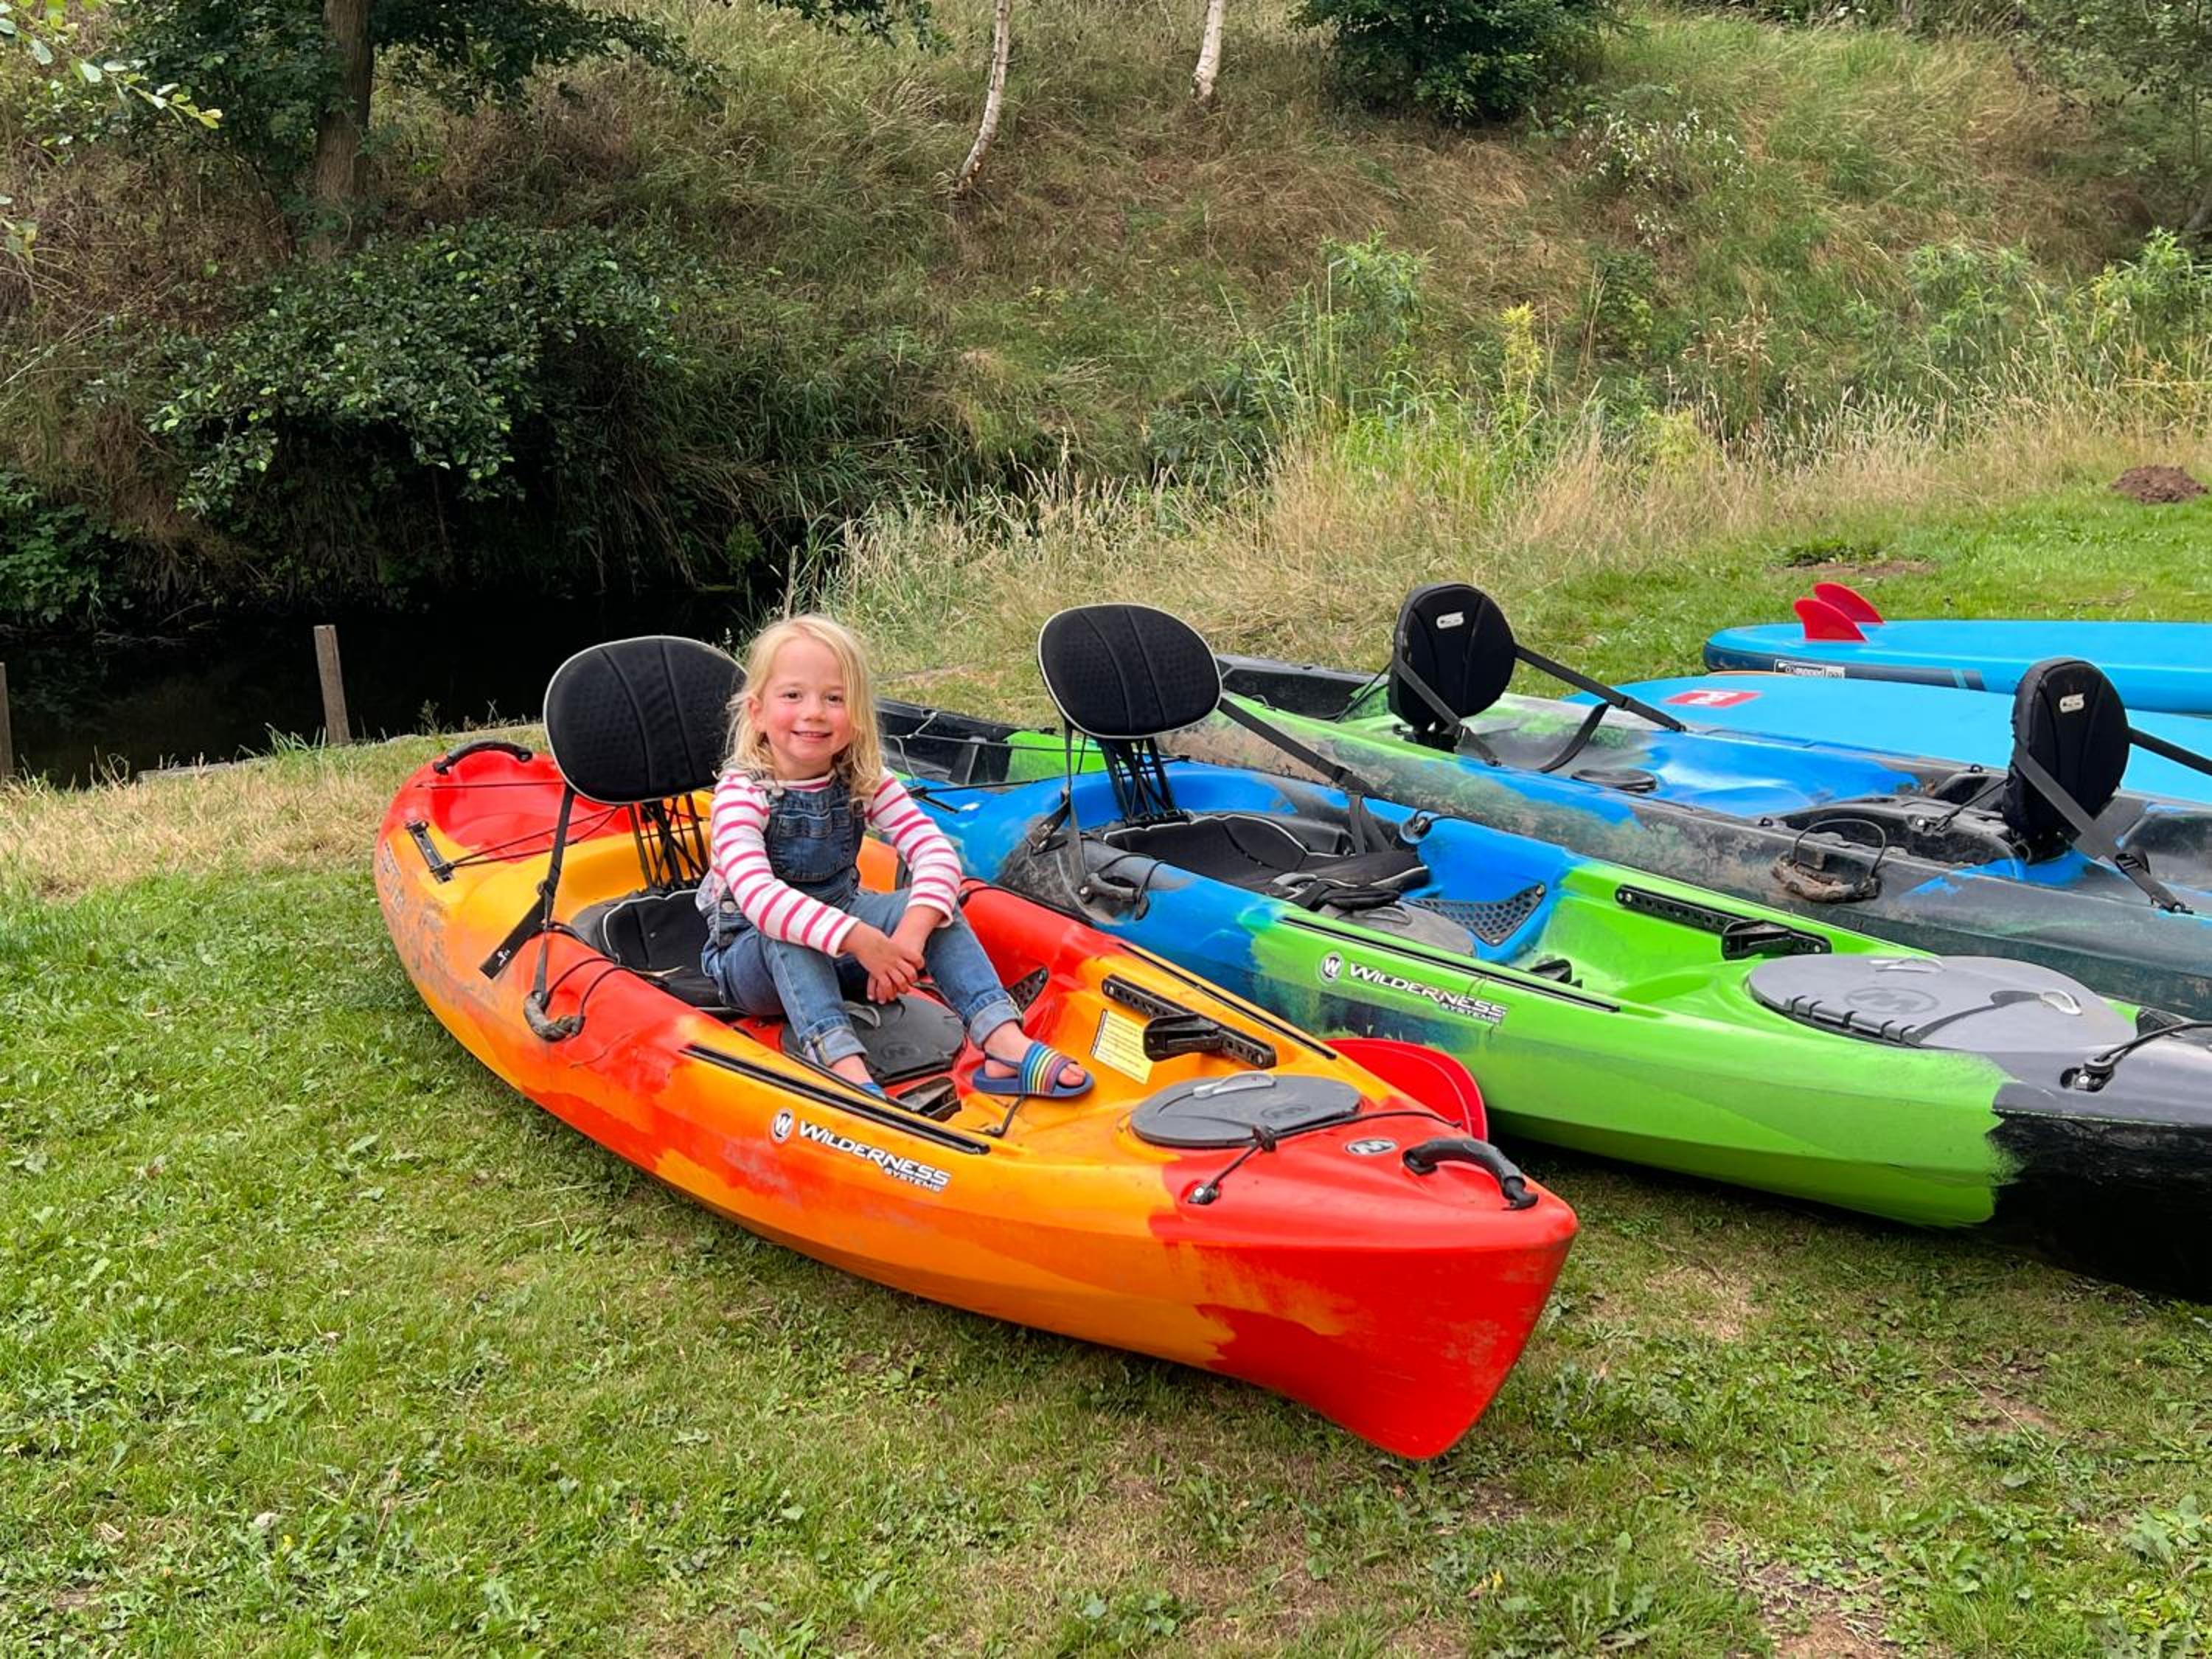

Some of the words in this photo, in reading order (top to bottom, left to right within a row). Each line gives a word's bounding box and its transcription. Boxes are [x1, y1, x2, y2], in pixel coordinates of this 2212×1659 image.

[1349, 962, 1508, 1018] WILDERNESS
[799, 1120, 951, 1187] WILDERNESS
[884, 1167, 944, 1192] SYSTEMS
